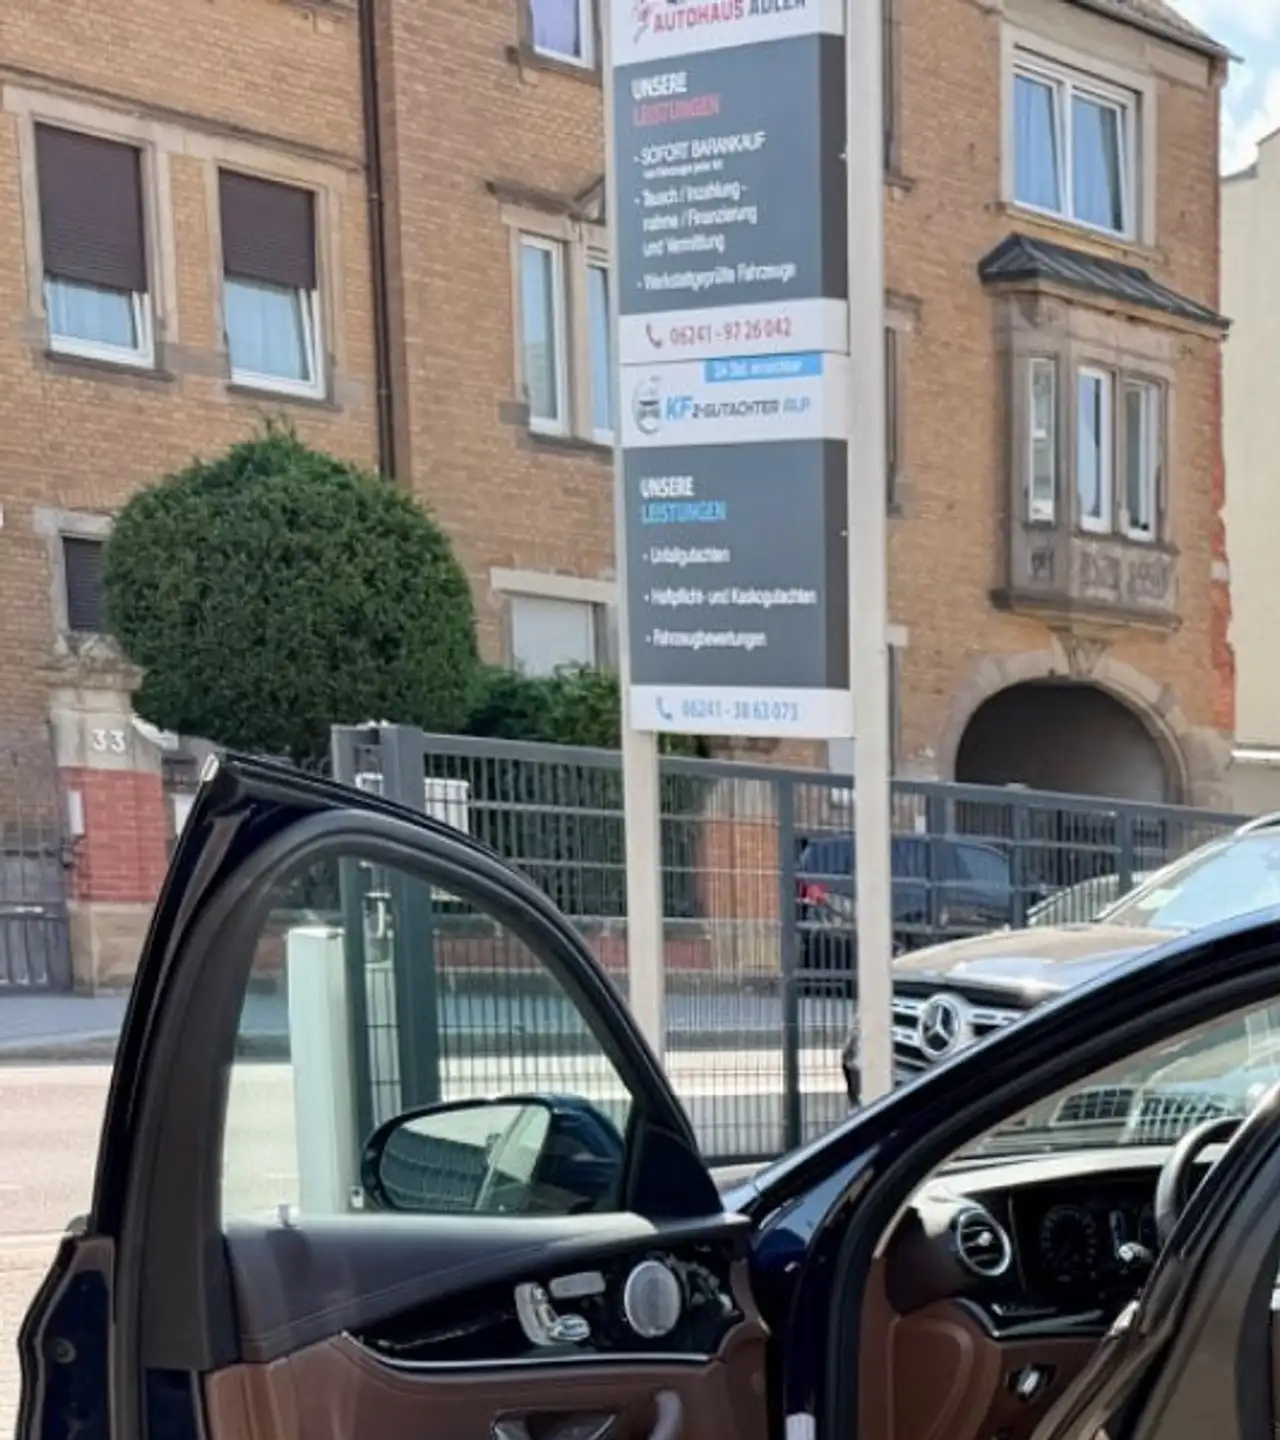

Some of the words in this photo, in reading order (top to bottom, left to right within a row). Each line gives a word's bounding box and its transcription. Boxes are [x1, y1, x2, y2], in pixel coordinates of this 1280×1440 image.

[653, 0, 744, 34] AUTOHAUS
[631, 71, 688, 101] UNSERE
[639, 475, 695, 499] UNSERE
[641, 500, 728, 525] LEISTUNGEN
[91, 728, 127, 754] 33
